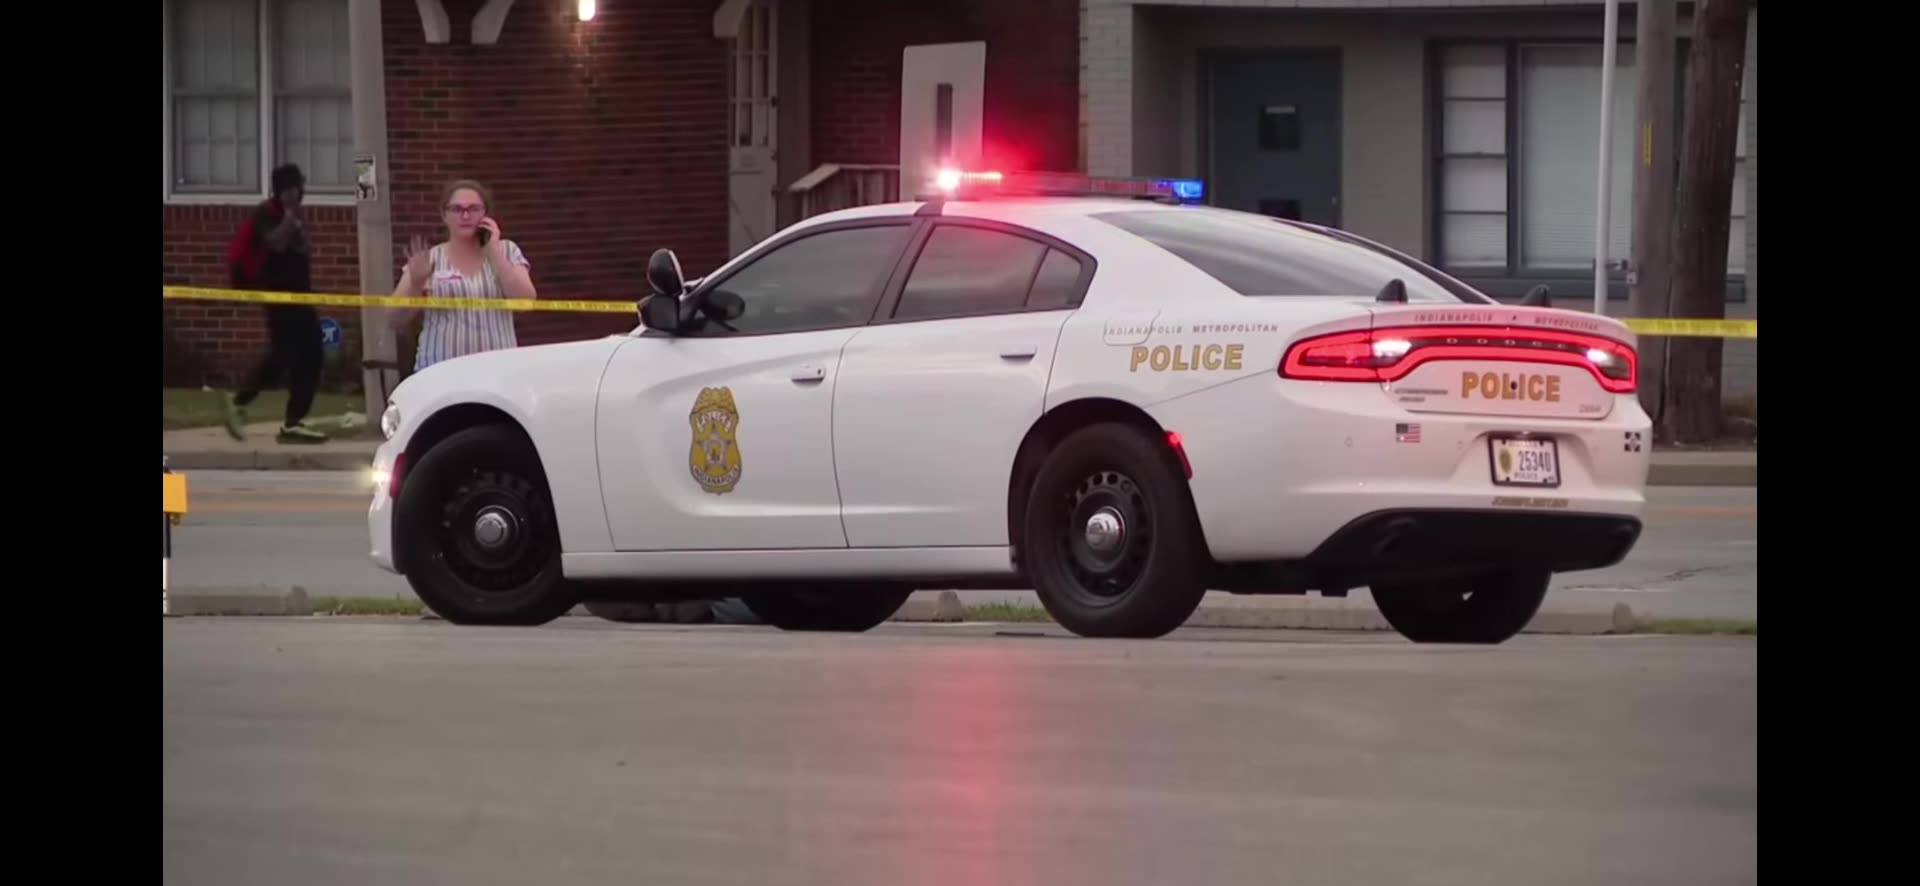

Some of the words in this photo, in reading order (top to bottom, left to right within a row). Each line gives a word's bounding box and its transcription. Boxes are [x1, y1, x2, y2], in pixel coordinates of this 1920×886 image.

[1103, 325, 1183, 336] INDIANAPOLIS
[1192, 324, 1278, 333] METROPOLITAN
[1129, 343, 1245, 373] POLICE
[1461, 371, 1561, 402] POLICE
[698, 410, 731, 428] POLICE
[1518, 450, 1552, 473] 25340
